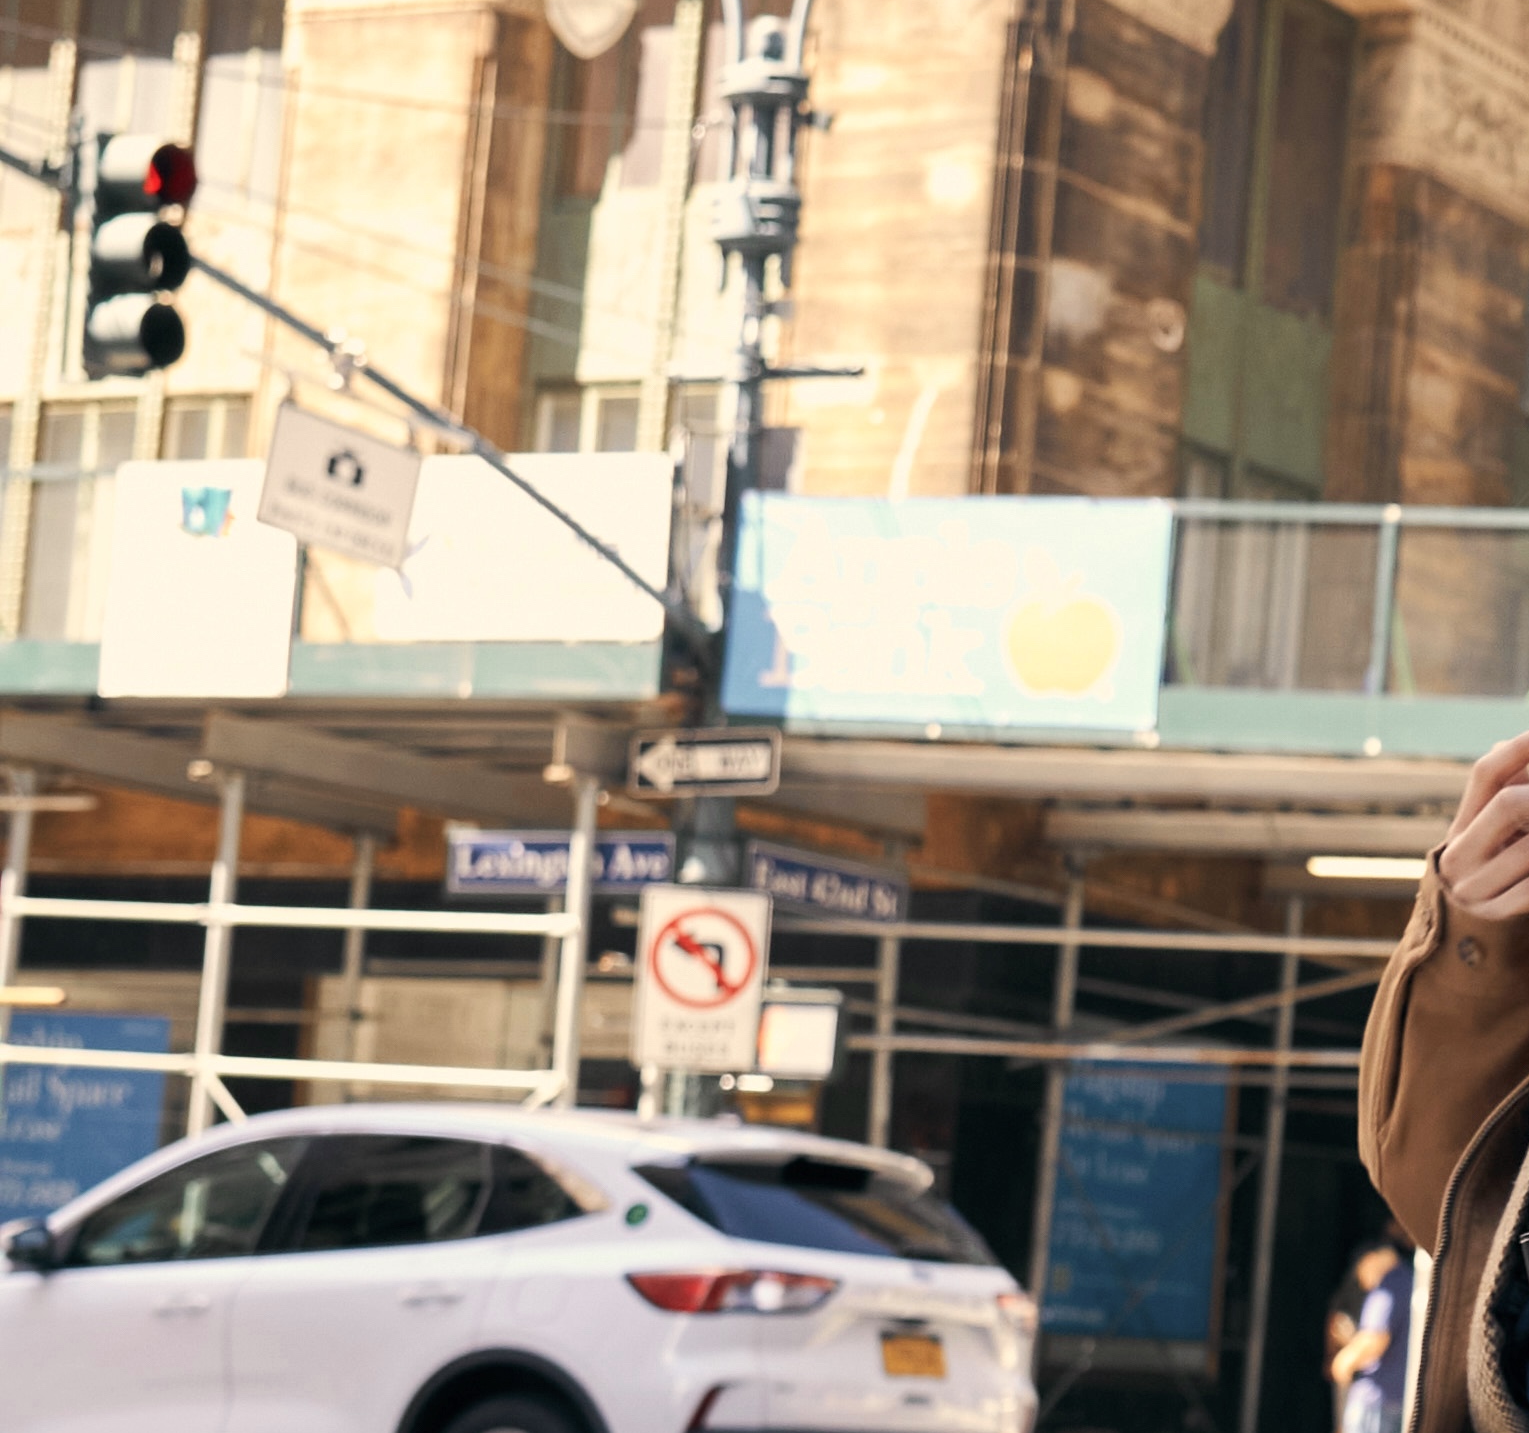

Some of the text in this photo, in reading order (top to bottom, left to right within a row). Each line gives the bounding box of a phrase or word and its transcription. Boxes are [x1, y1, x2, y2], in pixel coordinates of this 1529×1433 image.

[719, 747, 761, 769] WAY
[457, 842, 670, 888] Lexingn Ave
[755, 856, 898, 919] East 42nd St
